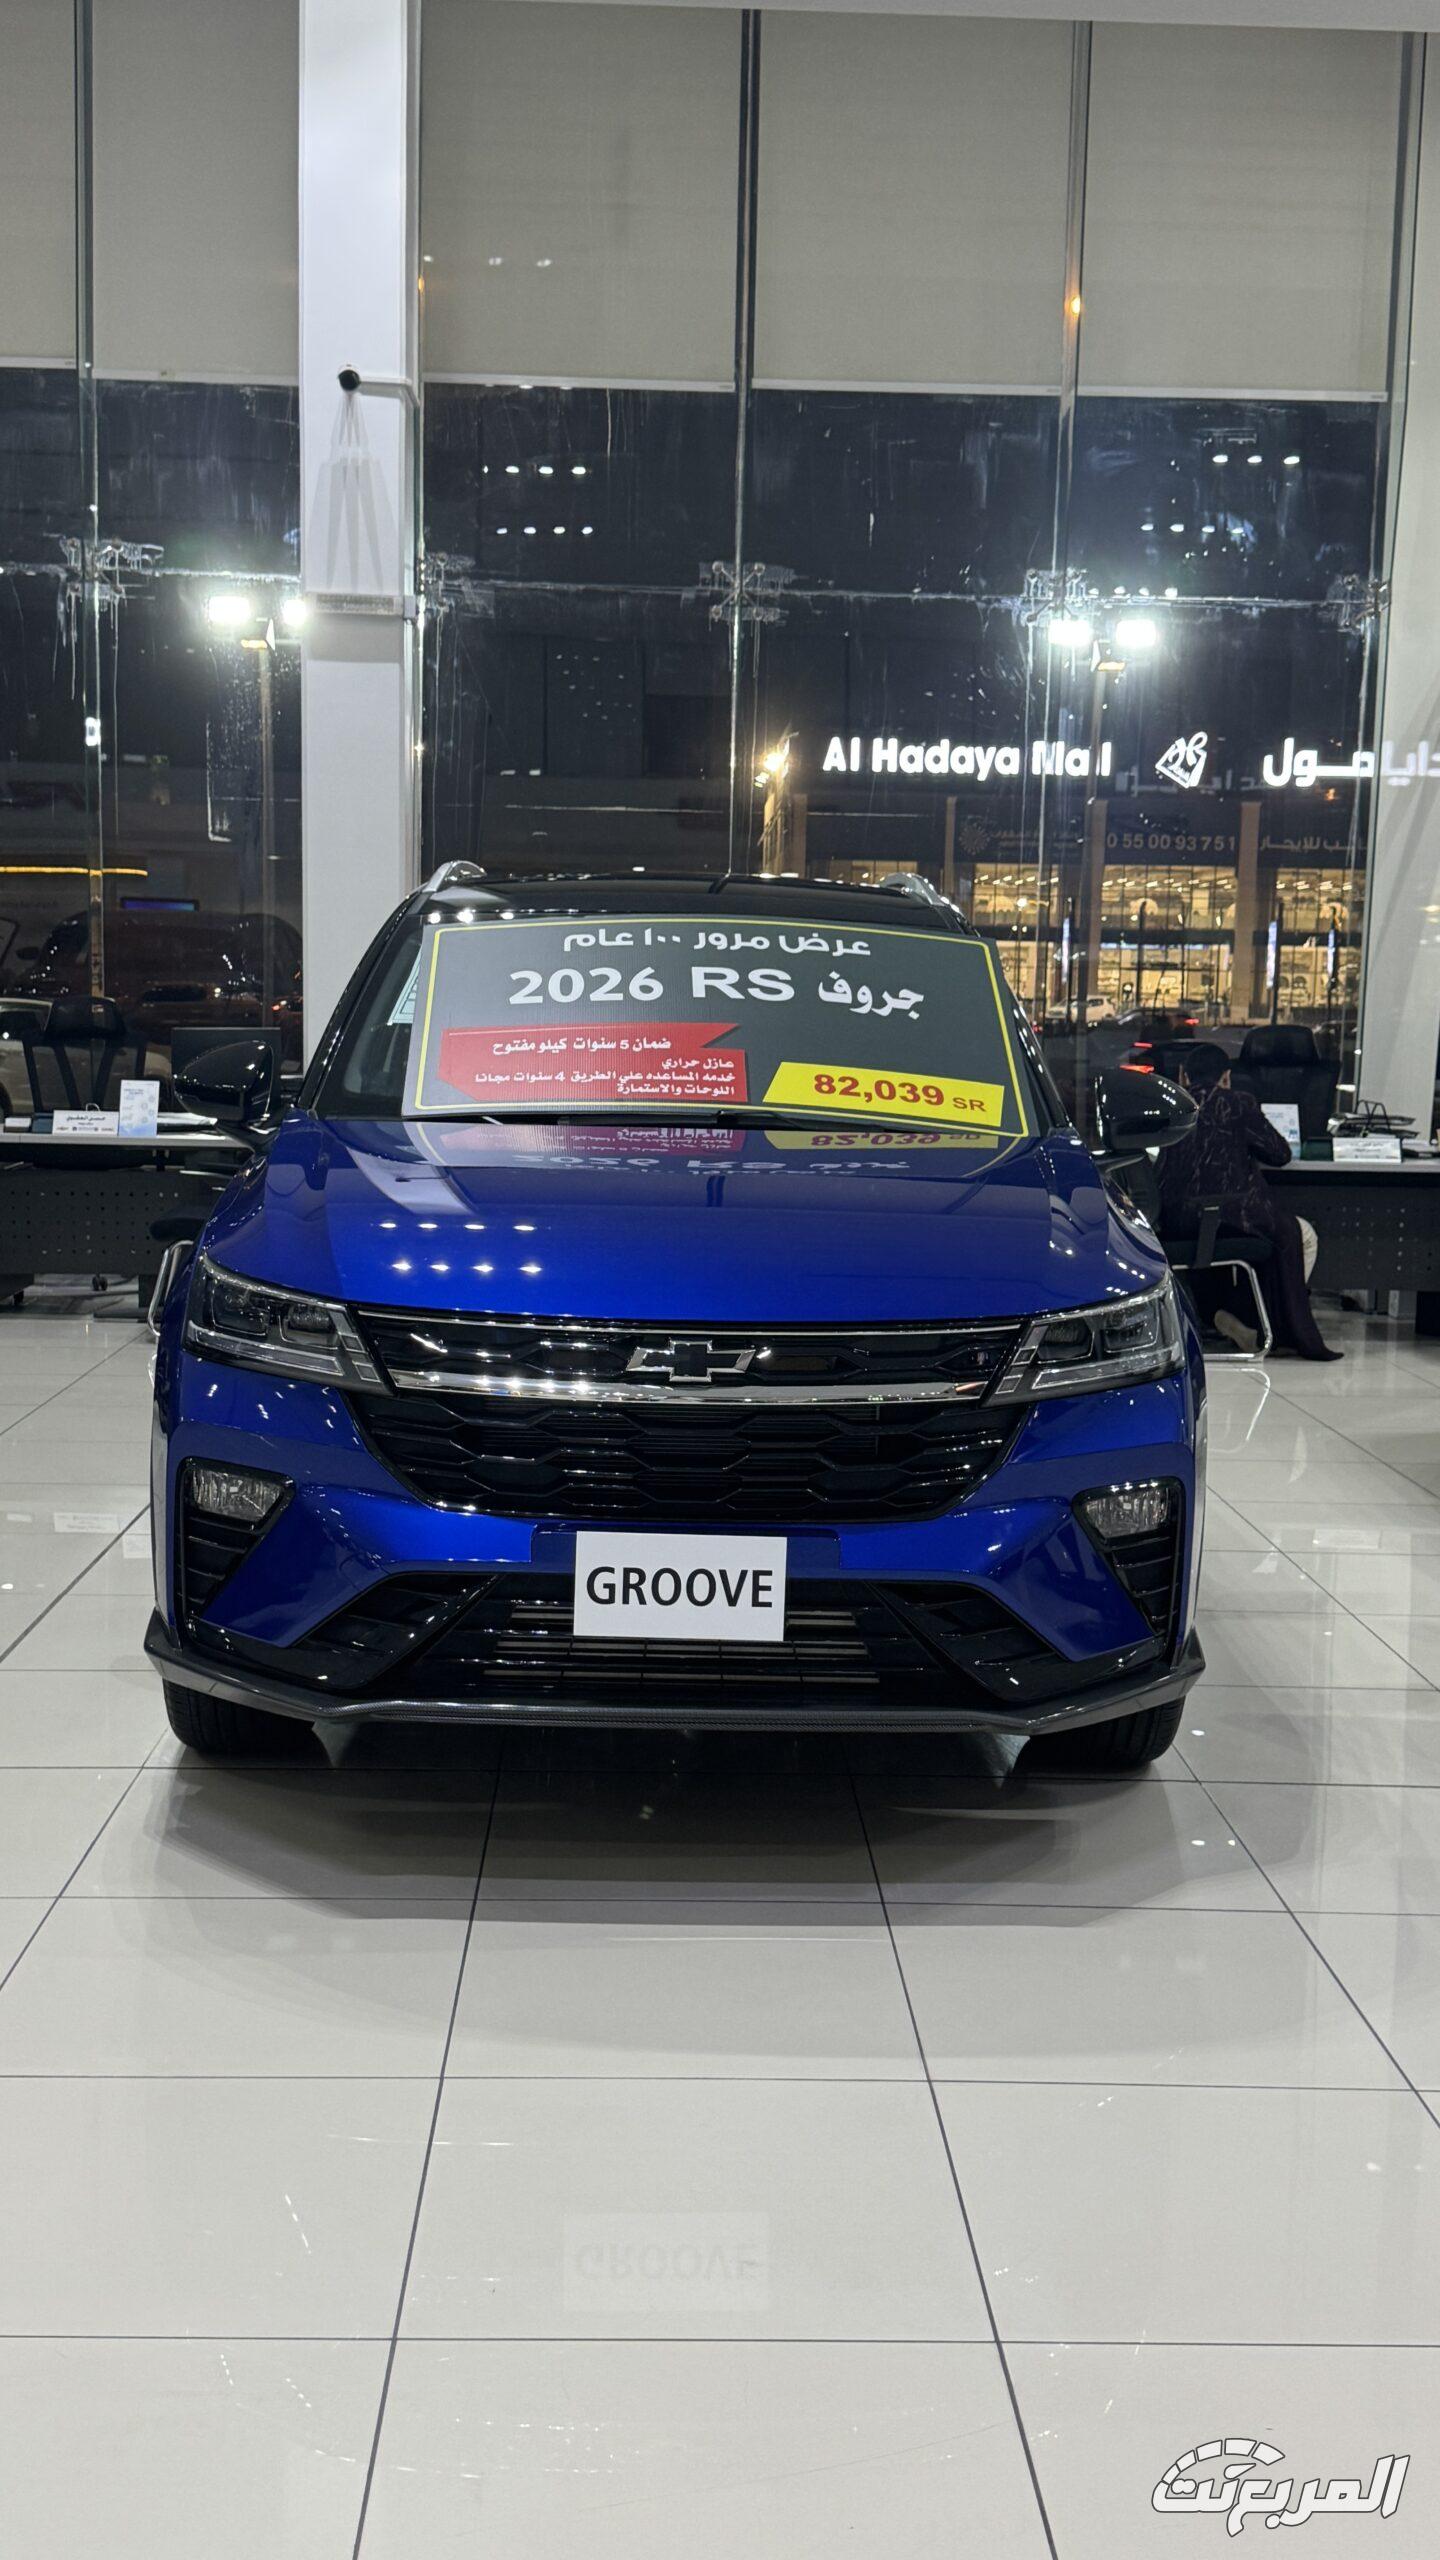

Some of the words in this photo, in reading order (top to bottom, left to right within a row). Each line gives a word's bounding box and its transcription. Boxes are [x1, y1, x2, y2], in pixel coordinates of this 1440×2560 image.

[822, 736, 860, 772] Al
[871, 738, 1020, 781] Hadaya
[1032, 740, 1112, 776] Mal
[564, 928, 634, 951] عام
[694, 932, 770, 950] مرور
[779, 932, 871, 956] عرض
[509, 967, 663, 1004] 2026
[691, 966, 795, 1001] RS
[818, 971, 924, 1020] جروف
[492, 1038, 536, 1055] مفتوح
[538, 1037, 568, 1054] كيلو
[573, 1037, 617, 1052] سنوات
[620, 1039, 629, 1050] 5
[632, 1037, 672, 1052] ضمان
[661, 1057, 700, 1070] حراري
[702, 1057, 735, 1069] عازل
[513, 1071, 553, 1083] سنوات
[555, 1071, 566, 1083] 4
[571, 1070, 617, 1084] الطريق
[684, 1083, 735, 1097] اللوحات
[814, 1073, 945, 1106] 82,039
[952, 1096, 986, 1112] SR
[586, 1565, 773, 1608] GROOVE
